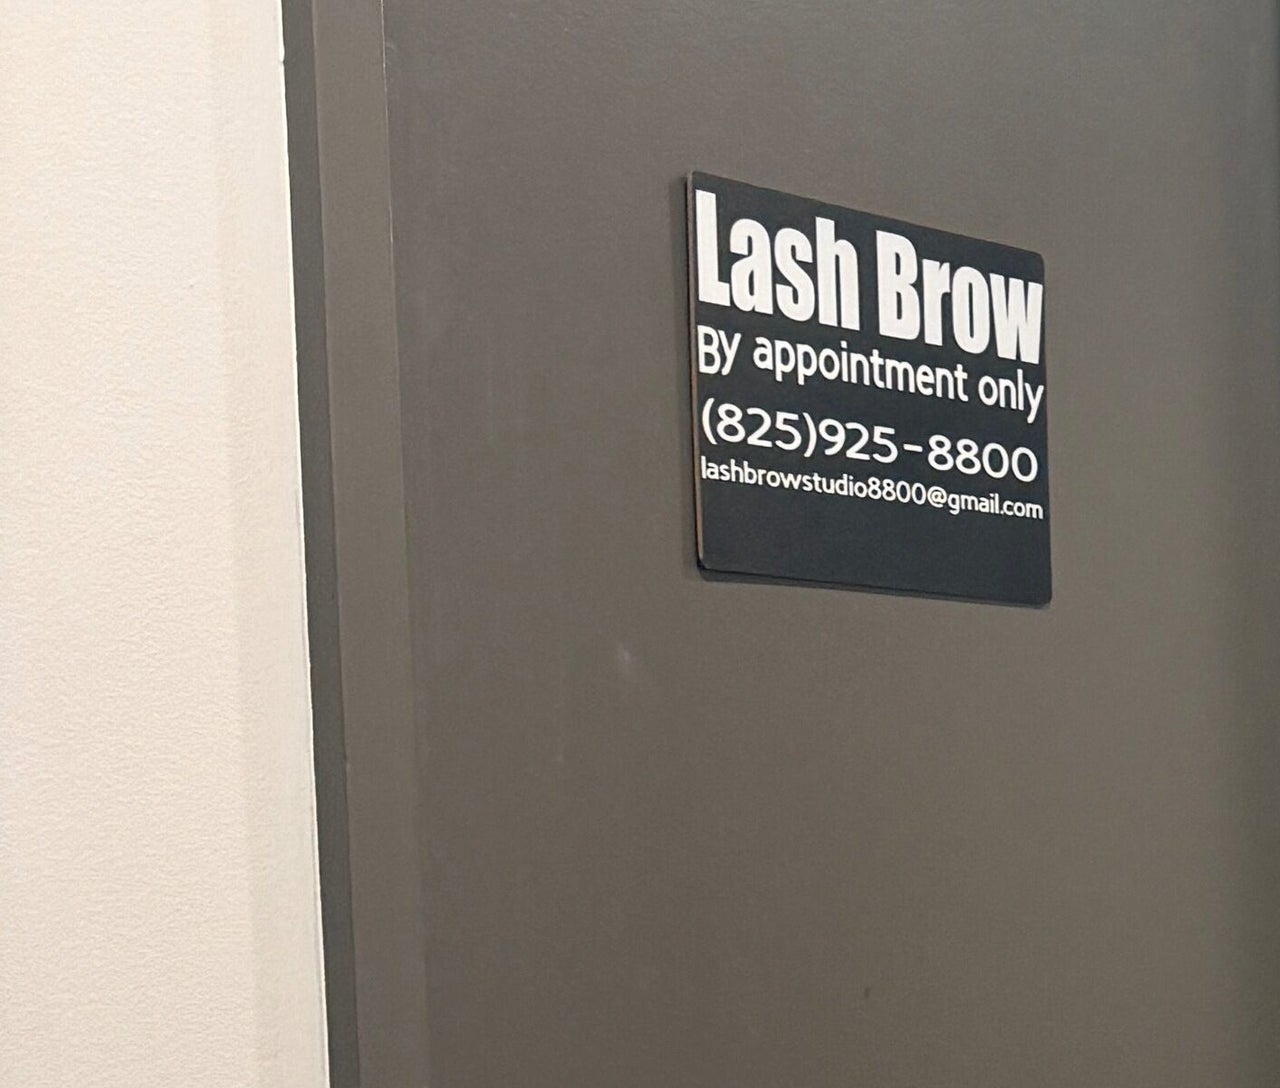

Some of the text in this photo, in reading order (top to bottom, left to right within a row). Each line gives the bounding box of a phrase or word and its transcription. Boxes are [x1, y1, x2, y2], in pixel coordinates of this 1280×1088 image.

[695, 189, 1043, 365] Lash Brow
[697, 325, 1045, 424] By appointment only
[701, 397, 1039, 483] (825)925-8800
[700, 455, 1044, 520] lashbrowstudio8800@gmail.com
